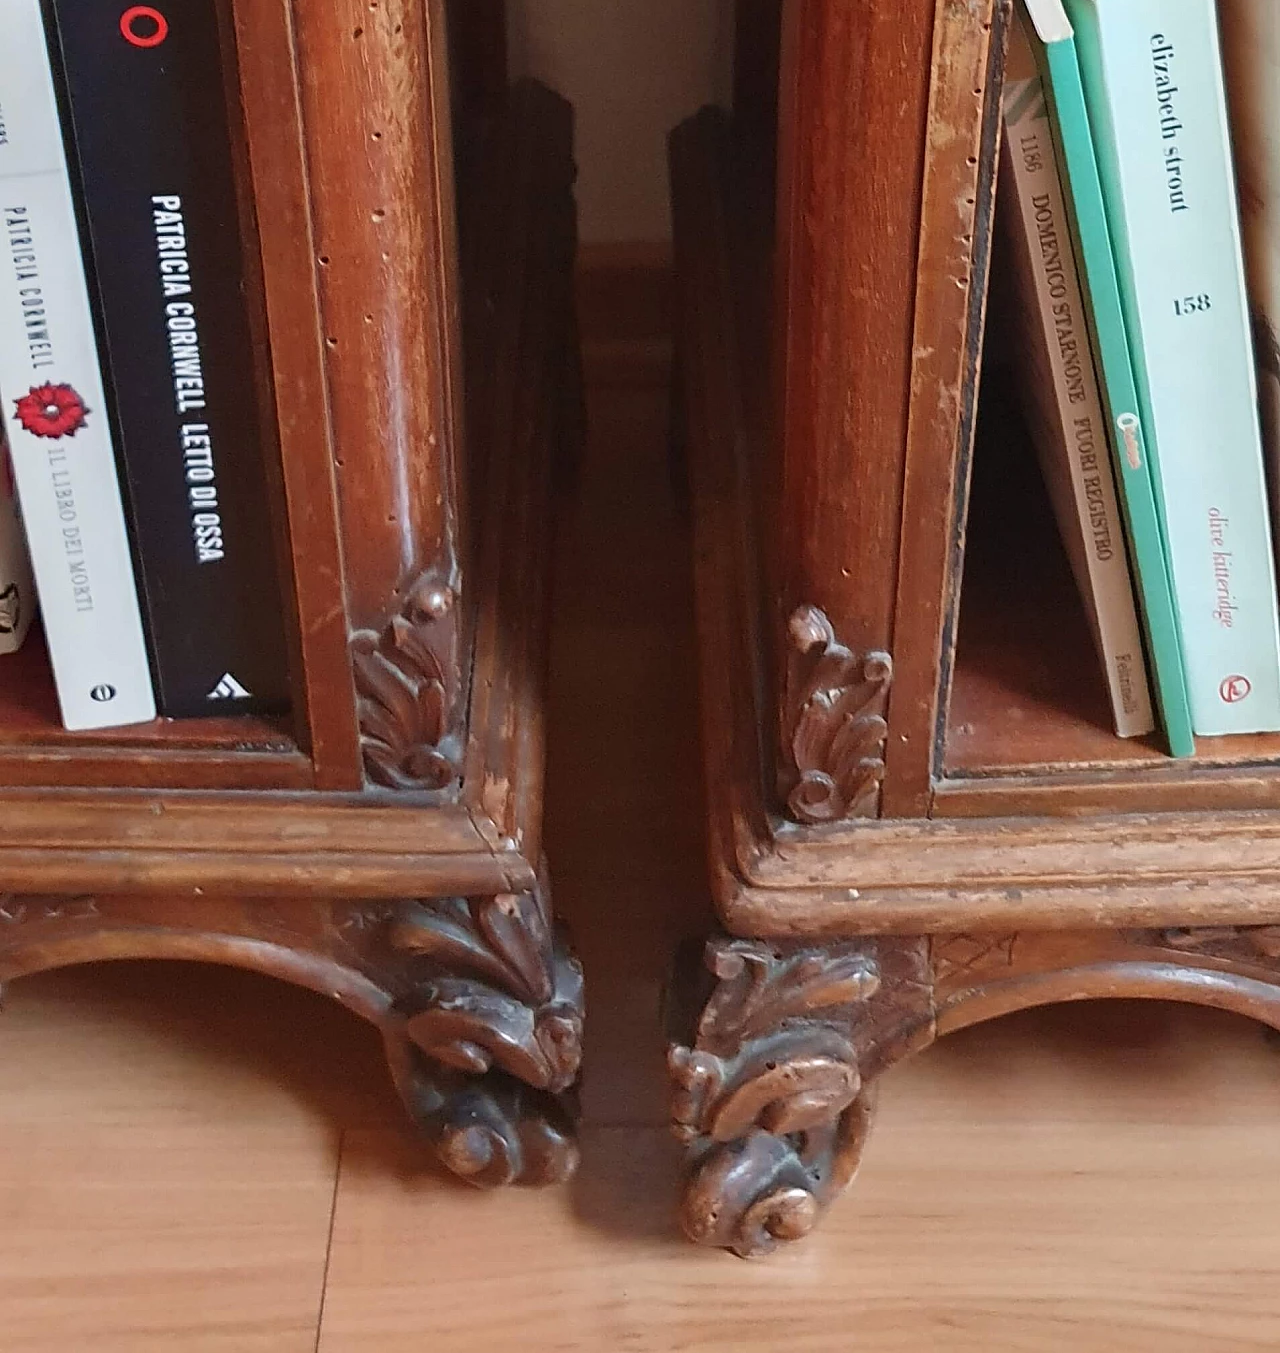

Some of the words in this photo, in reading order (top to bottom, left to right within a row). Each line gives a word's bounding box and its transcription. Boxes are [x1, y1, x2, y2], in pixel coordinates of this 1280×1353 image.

[1150, 32, 1183, 139] elizabeth
[1020, 133, 1042, 173] 1186
[1163, 146, 1190, 212] strout
[4, 206, 38, 281] PATRICIA
[151, 195, 192, 297] PATRICIA
[1032, 193, 1067, 299] DOMENICO
[1053, 302, 1086, 404] STARNONE
[1173, 293, 1212, 316] 158
[19, 288, 54, 369] CORNWELL
[165, 302, 206, 413] CORNWELL
[48, 447, 66, 467] IL
[180, 423, 215, 483] LETTO
[1073, 415, 1099, 472] FUORI
[52, 469, 77, 525] LIBRO
[190, 486, 219, 509] DI
[1084, 473, 1114, 562] REGISTRO
[62, 526, 84, 557] DEI
[193, 513, 225, 564] OSSA
[1207, 506, 1230, 547] olive
[69, 559, 94, 613] MORTI
[1213, 551, 1239, 629] kitteridge
